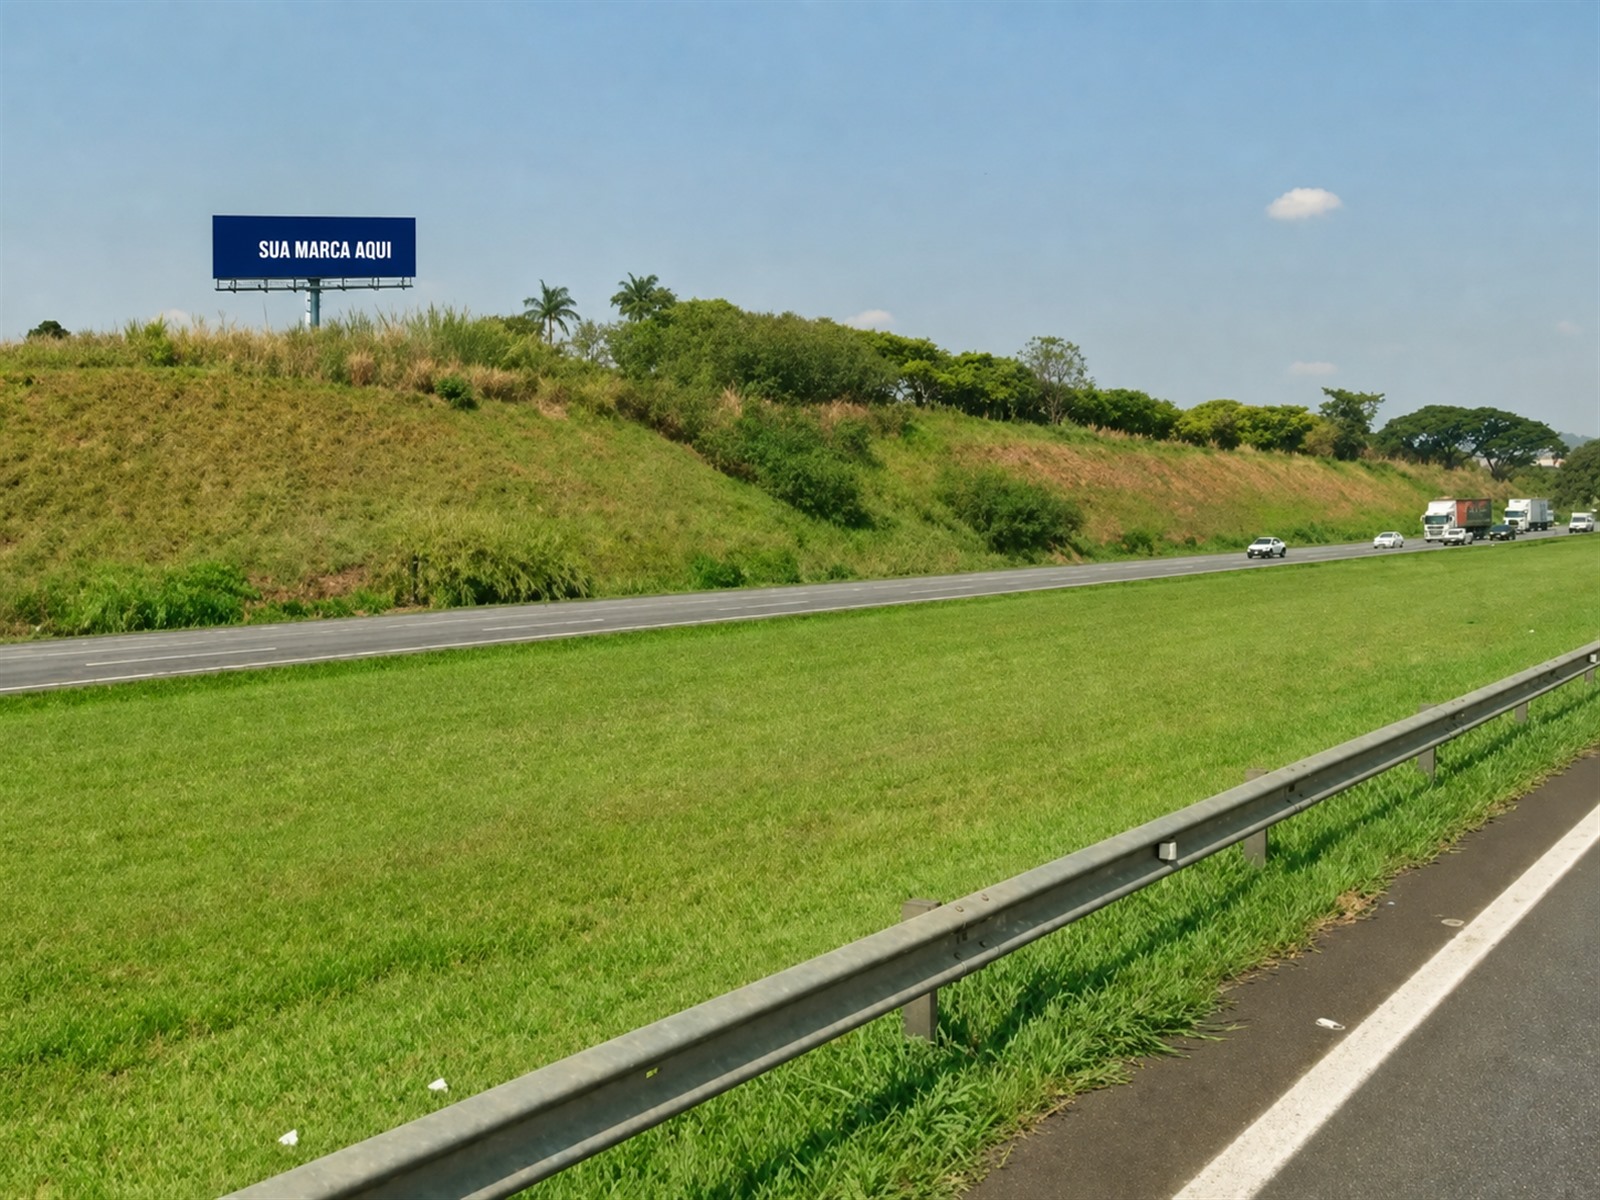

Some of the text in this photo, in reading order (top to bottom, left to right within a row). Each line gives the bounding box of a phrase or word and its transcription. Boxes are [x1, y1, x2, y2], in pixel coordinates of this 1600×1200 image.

[259, 240, 391, 260] SUA MARCA AQUI
